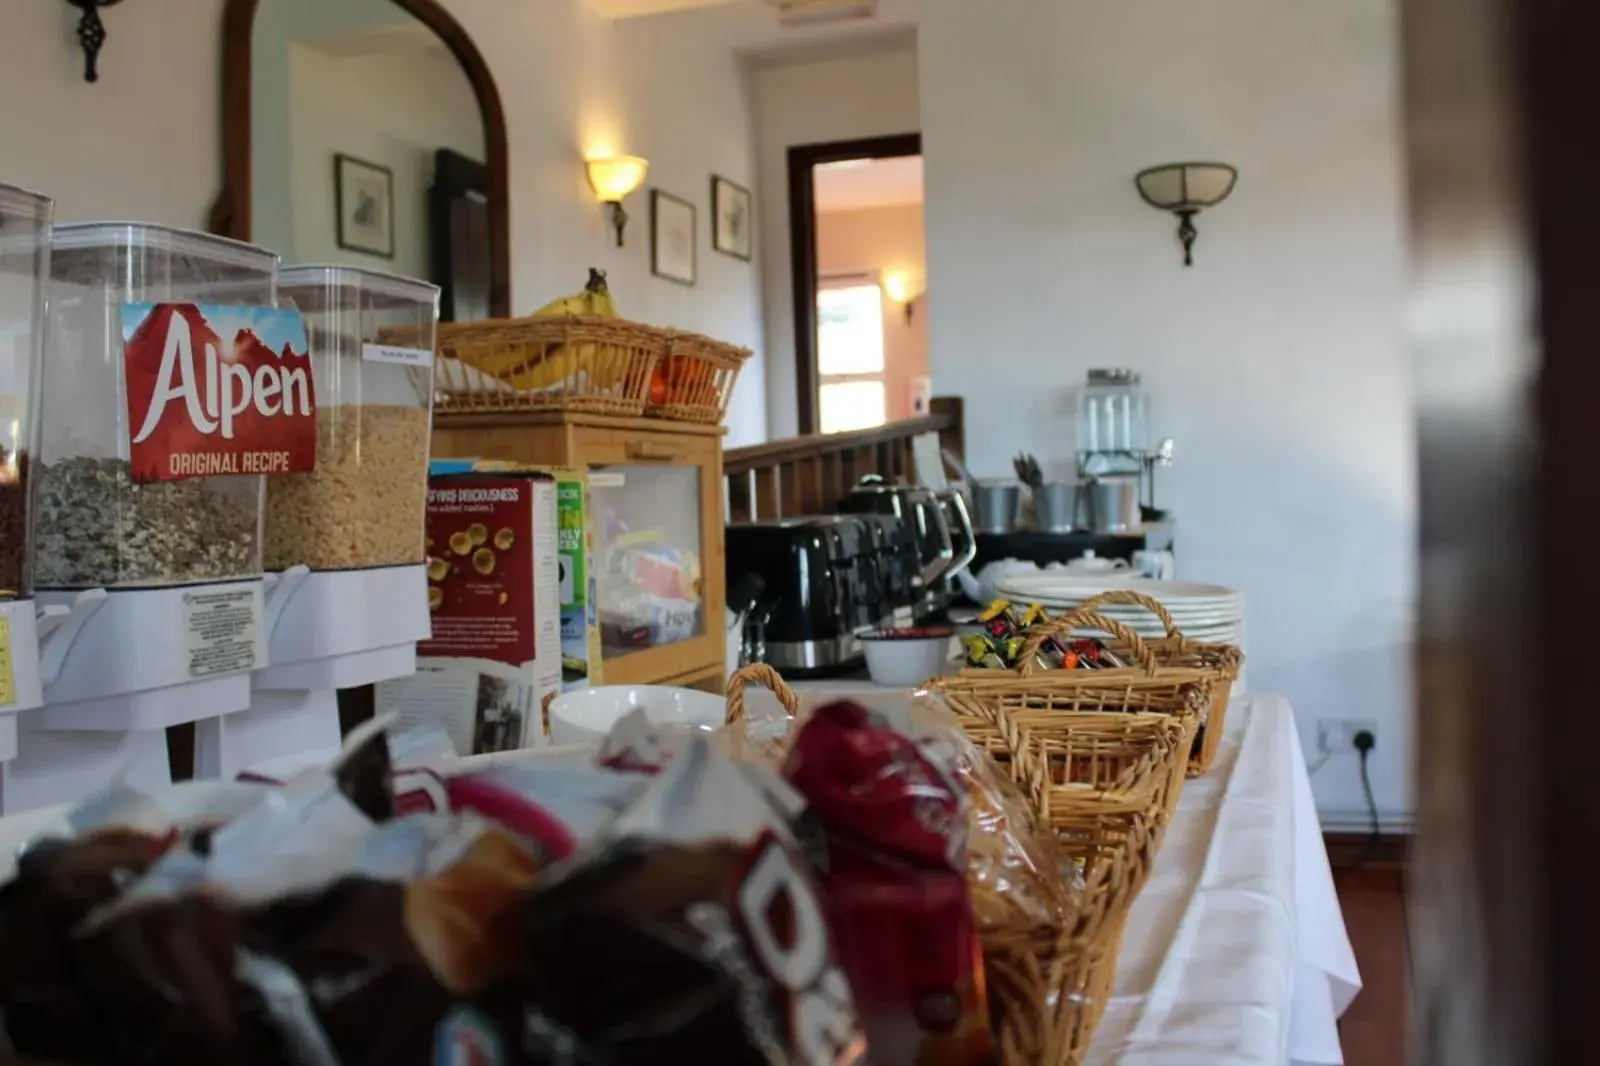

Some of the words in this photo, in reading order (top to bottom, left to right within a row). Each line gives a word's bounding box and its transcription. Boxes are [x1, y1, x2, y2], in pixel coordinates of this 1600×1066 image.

[132, 310, 311, 444] Alpen
[169, 452, 239, 475] ORIGINAL
[242, 451, 290, 472] RECIPE
